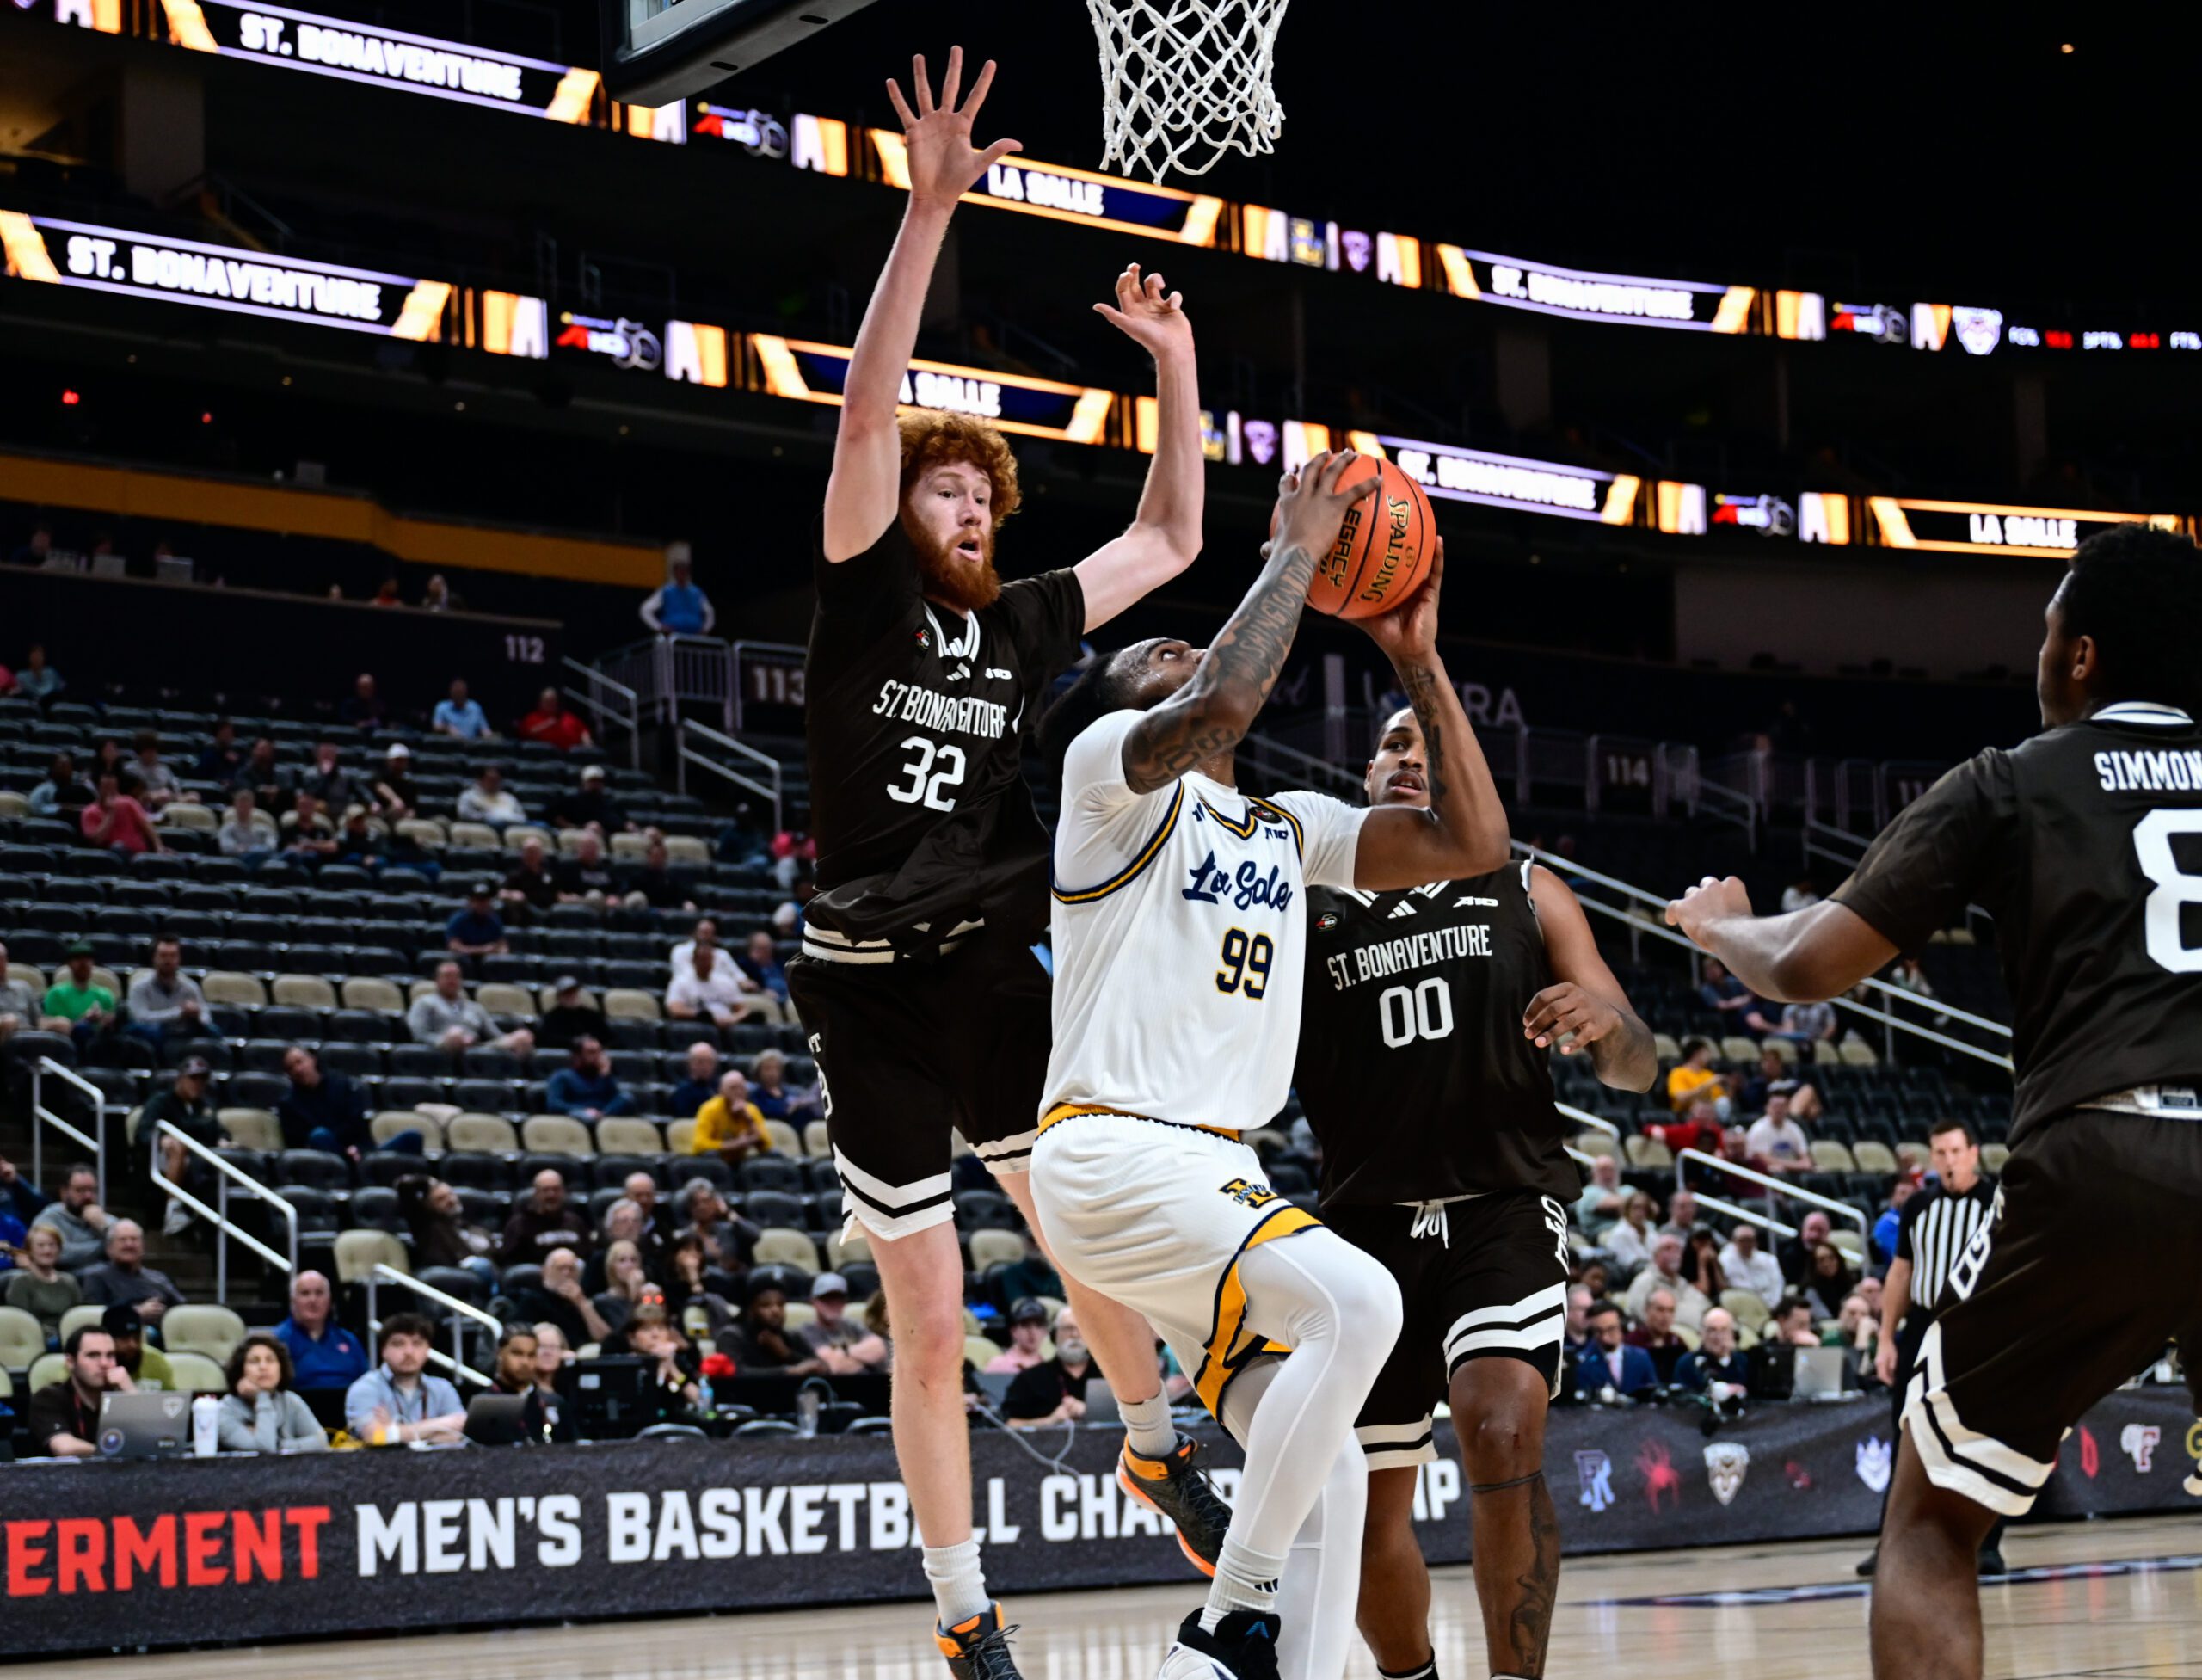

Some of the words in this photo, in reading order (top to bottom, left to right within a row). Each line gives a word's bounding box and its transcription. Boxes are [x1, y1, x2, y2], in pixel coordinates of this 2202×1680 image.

[241, 14, 292, 55] ST.
[298, 24, 522, 100] BONAVENTURE
[988, 163, 1024, 201] LA
[68, 237, 125, 280] ST.
[132, 246, 381, 320] BONAVENTURE
[1328, 507, 1363, 588] EGACY
[1360, 495, 1410, 602] SPALDING
[505, 635, 544, 663] 112
[886, 735, 967, 813] 32
[1607, 755, 1649, 787] 114
[1182, 849, 1233, 905] La
[1215, 925, 1274, 1001] 99
[1327, 952, 1356, 991] ST.
[1355, 924, 1492, 982] BONAVENTURE
[1379, 976, 1455, 1049] 00
[6, 1505, 331, 1597] ERMENT
[355, 1493, 582, 1578] MEN'S
[606, 1476, 1021, 1564] BASKETBL
